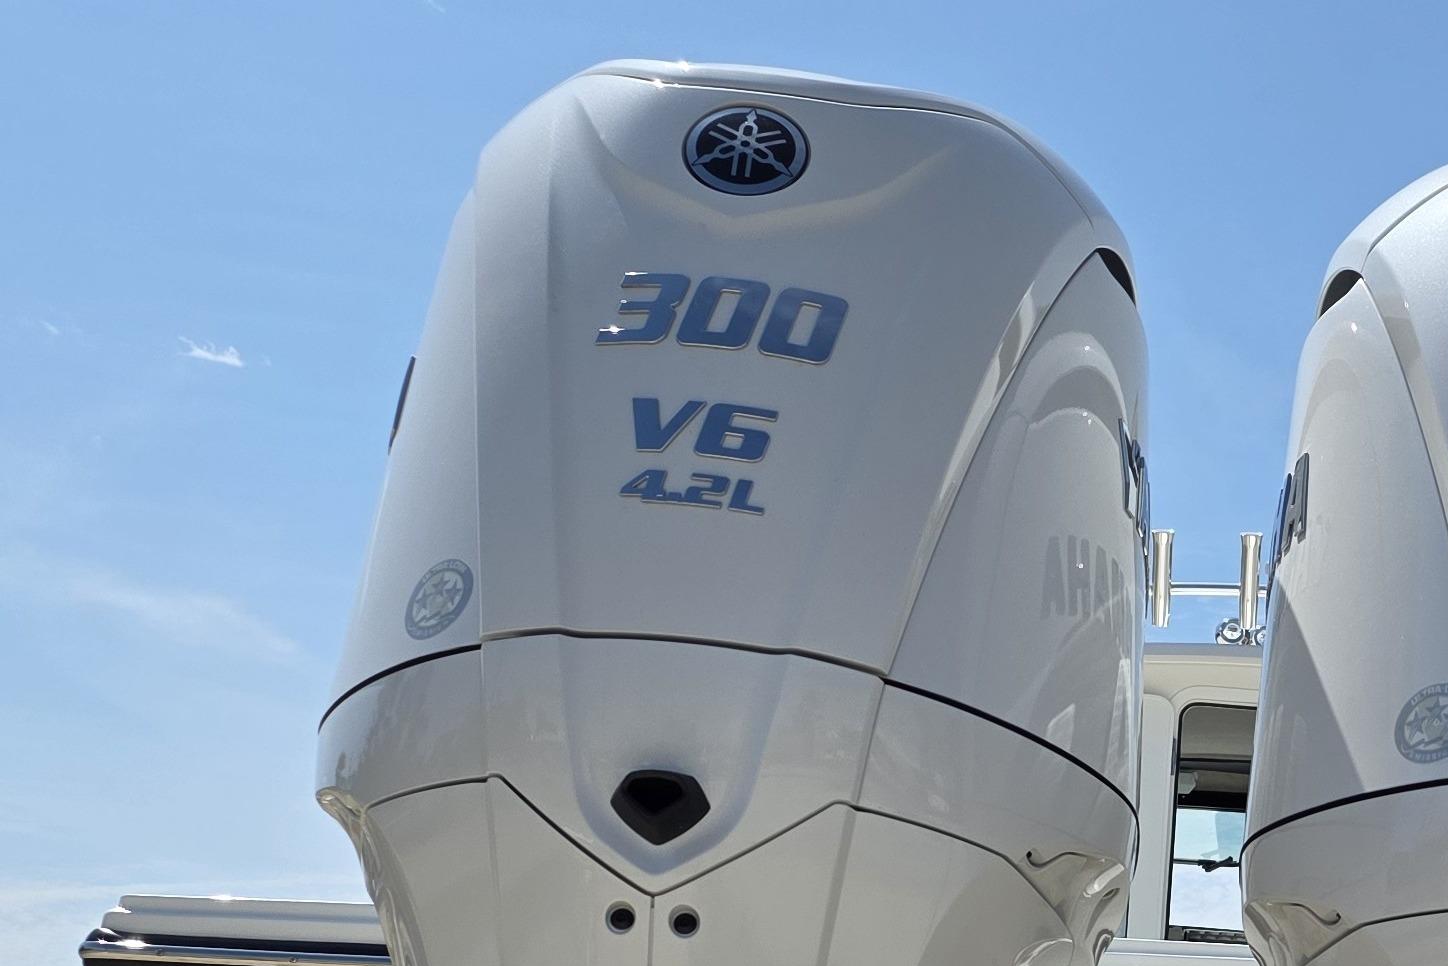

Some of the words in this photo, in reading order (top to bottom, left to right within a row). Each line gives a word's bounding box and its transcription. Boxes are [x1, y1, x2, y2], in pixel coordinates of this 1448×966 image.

[595, 271, 849, 365] 300
[632, 398, 779, 463] V6
[619, 468, 766, 516] 4.2L
